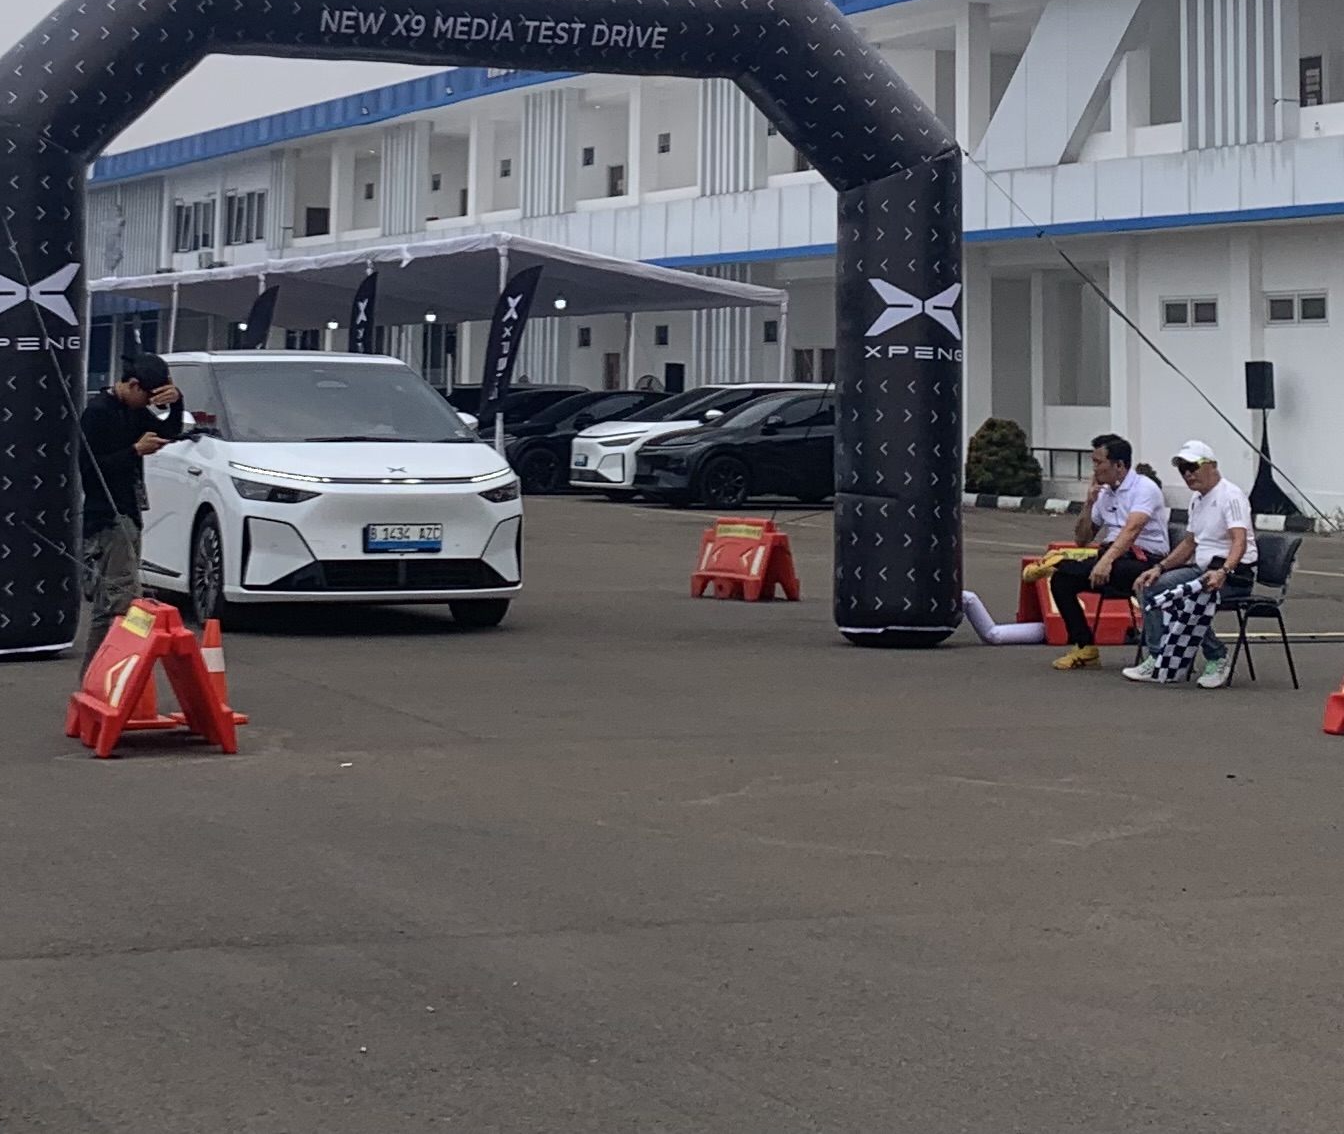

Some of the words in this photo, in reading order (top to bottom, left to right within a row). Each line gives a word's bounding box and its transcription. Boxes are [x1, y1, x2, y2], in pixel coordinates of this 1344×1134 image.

[320, 9, 386, 36] NEW
[391, 14, 426, 37] X9
[433, 16, 514, 42] MEDIA
[524, 20, 586, 44] TEST
[591, 23, 668, 49] DRIVE
[864, 345, 963, 362] XPENG
